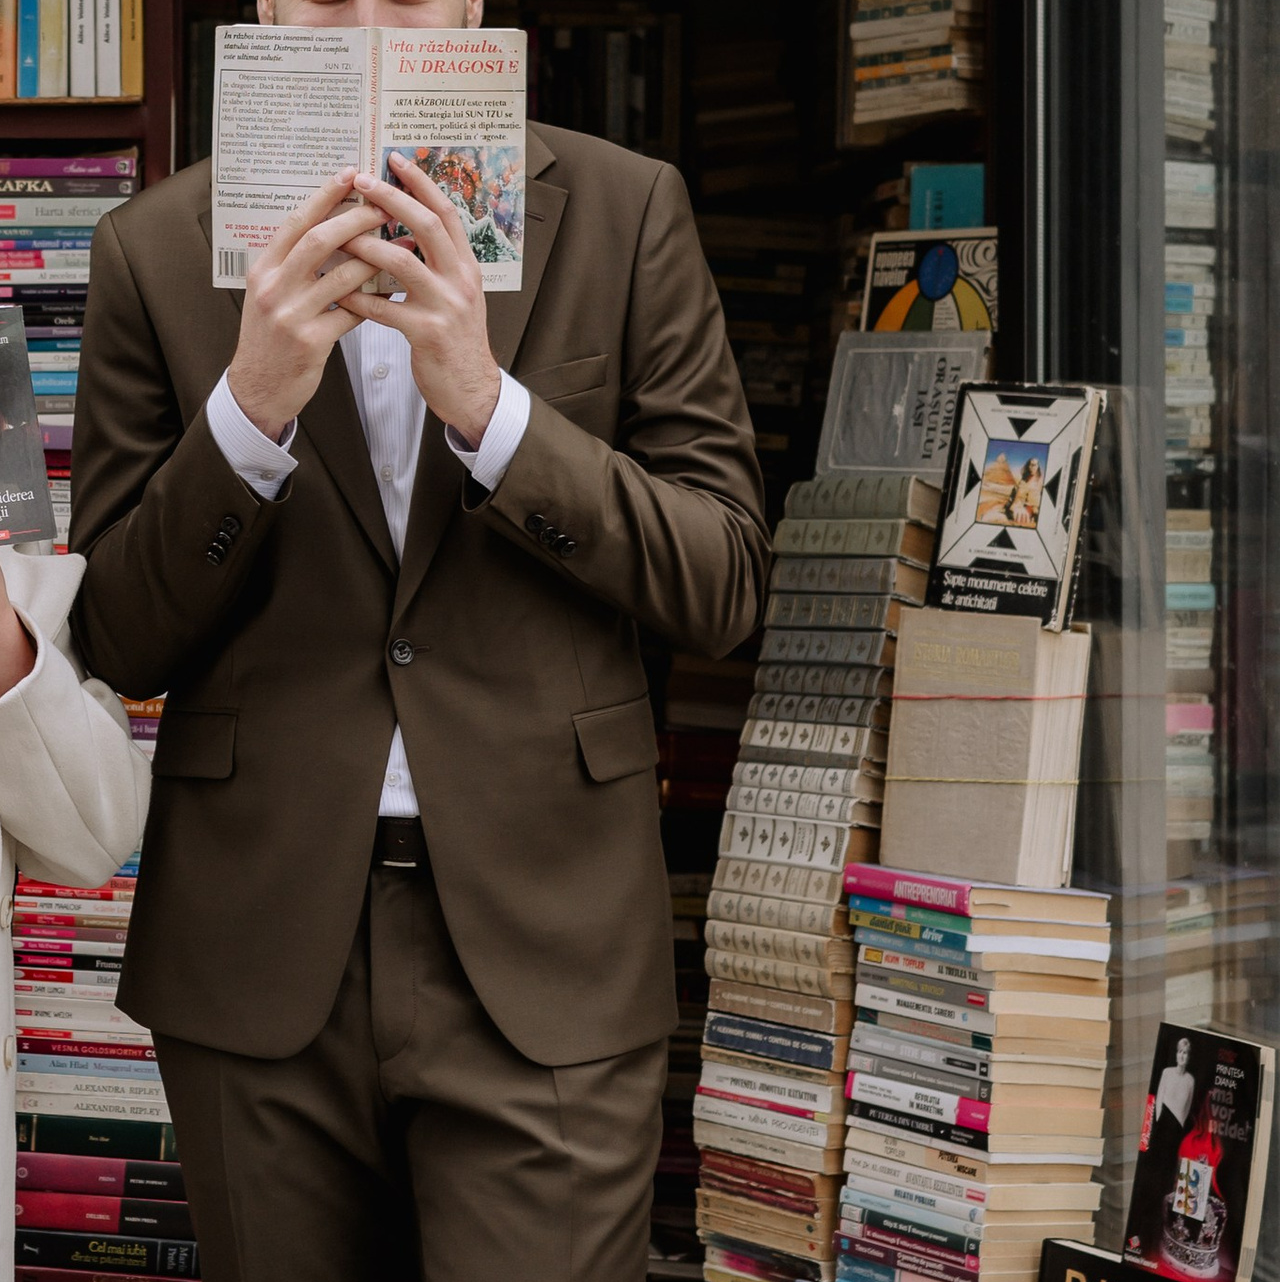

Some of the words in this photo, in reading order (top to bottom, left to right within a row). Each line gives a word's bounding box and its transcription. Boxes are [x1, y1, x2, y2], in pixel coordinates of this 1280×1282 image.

[274, 44, 311, 53] Distrugerea
[398, 56, 417, 75] ÎN
[420, 58, 520, 75] DRAGOSTE
[394, 98, 413, 107] ARTA
[414, 97, 466, 107] RĂZBOIULUI
[418, 110, 452, 120] Strategia
[454, 110, 464, 118] lui
[465, 110, 484, 119] SUN
[486, 110, 503, 118] TZU
[936, 364, 962, 452] ISTORIA
[967, 574, 1017, 595] monumente
[1017, 580, 1048, 598] celebre
[941, 588, 954, 607] ale
[893, 879, 959, 909] ANTREPRENORIAT
[921, 927, 944, 943] drive
[51, 1043, 79, 1053] VESNA
[81, 1045, 144, 1057] GOLDSWORTHY
[73, 1083, 127, 1095] ALEXANDRA
[128, 1085, 161, 1096] RIPLEY
[74, 1102, 127, 1114] ALEXANDRA
[129, 1105, 161, 1117] RIPLEY
